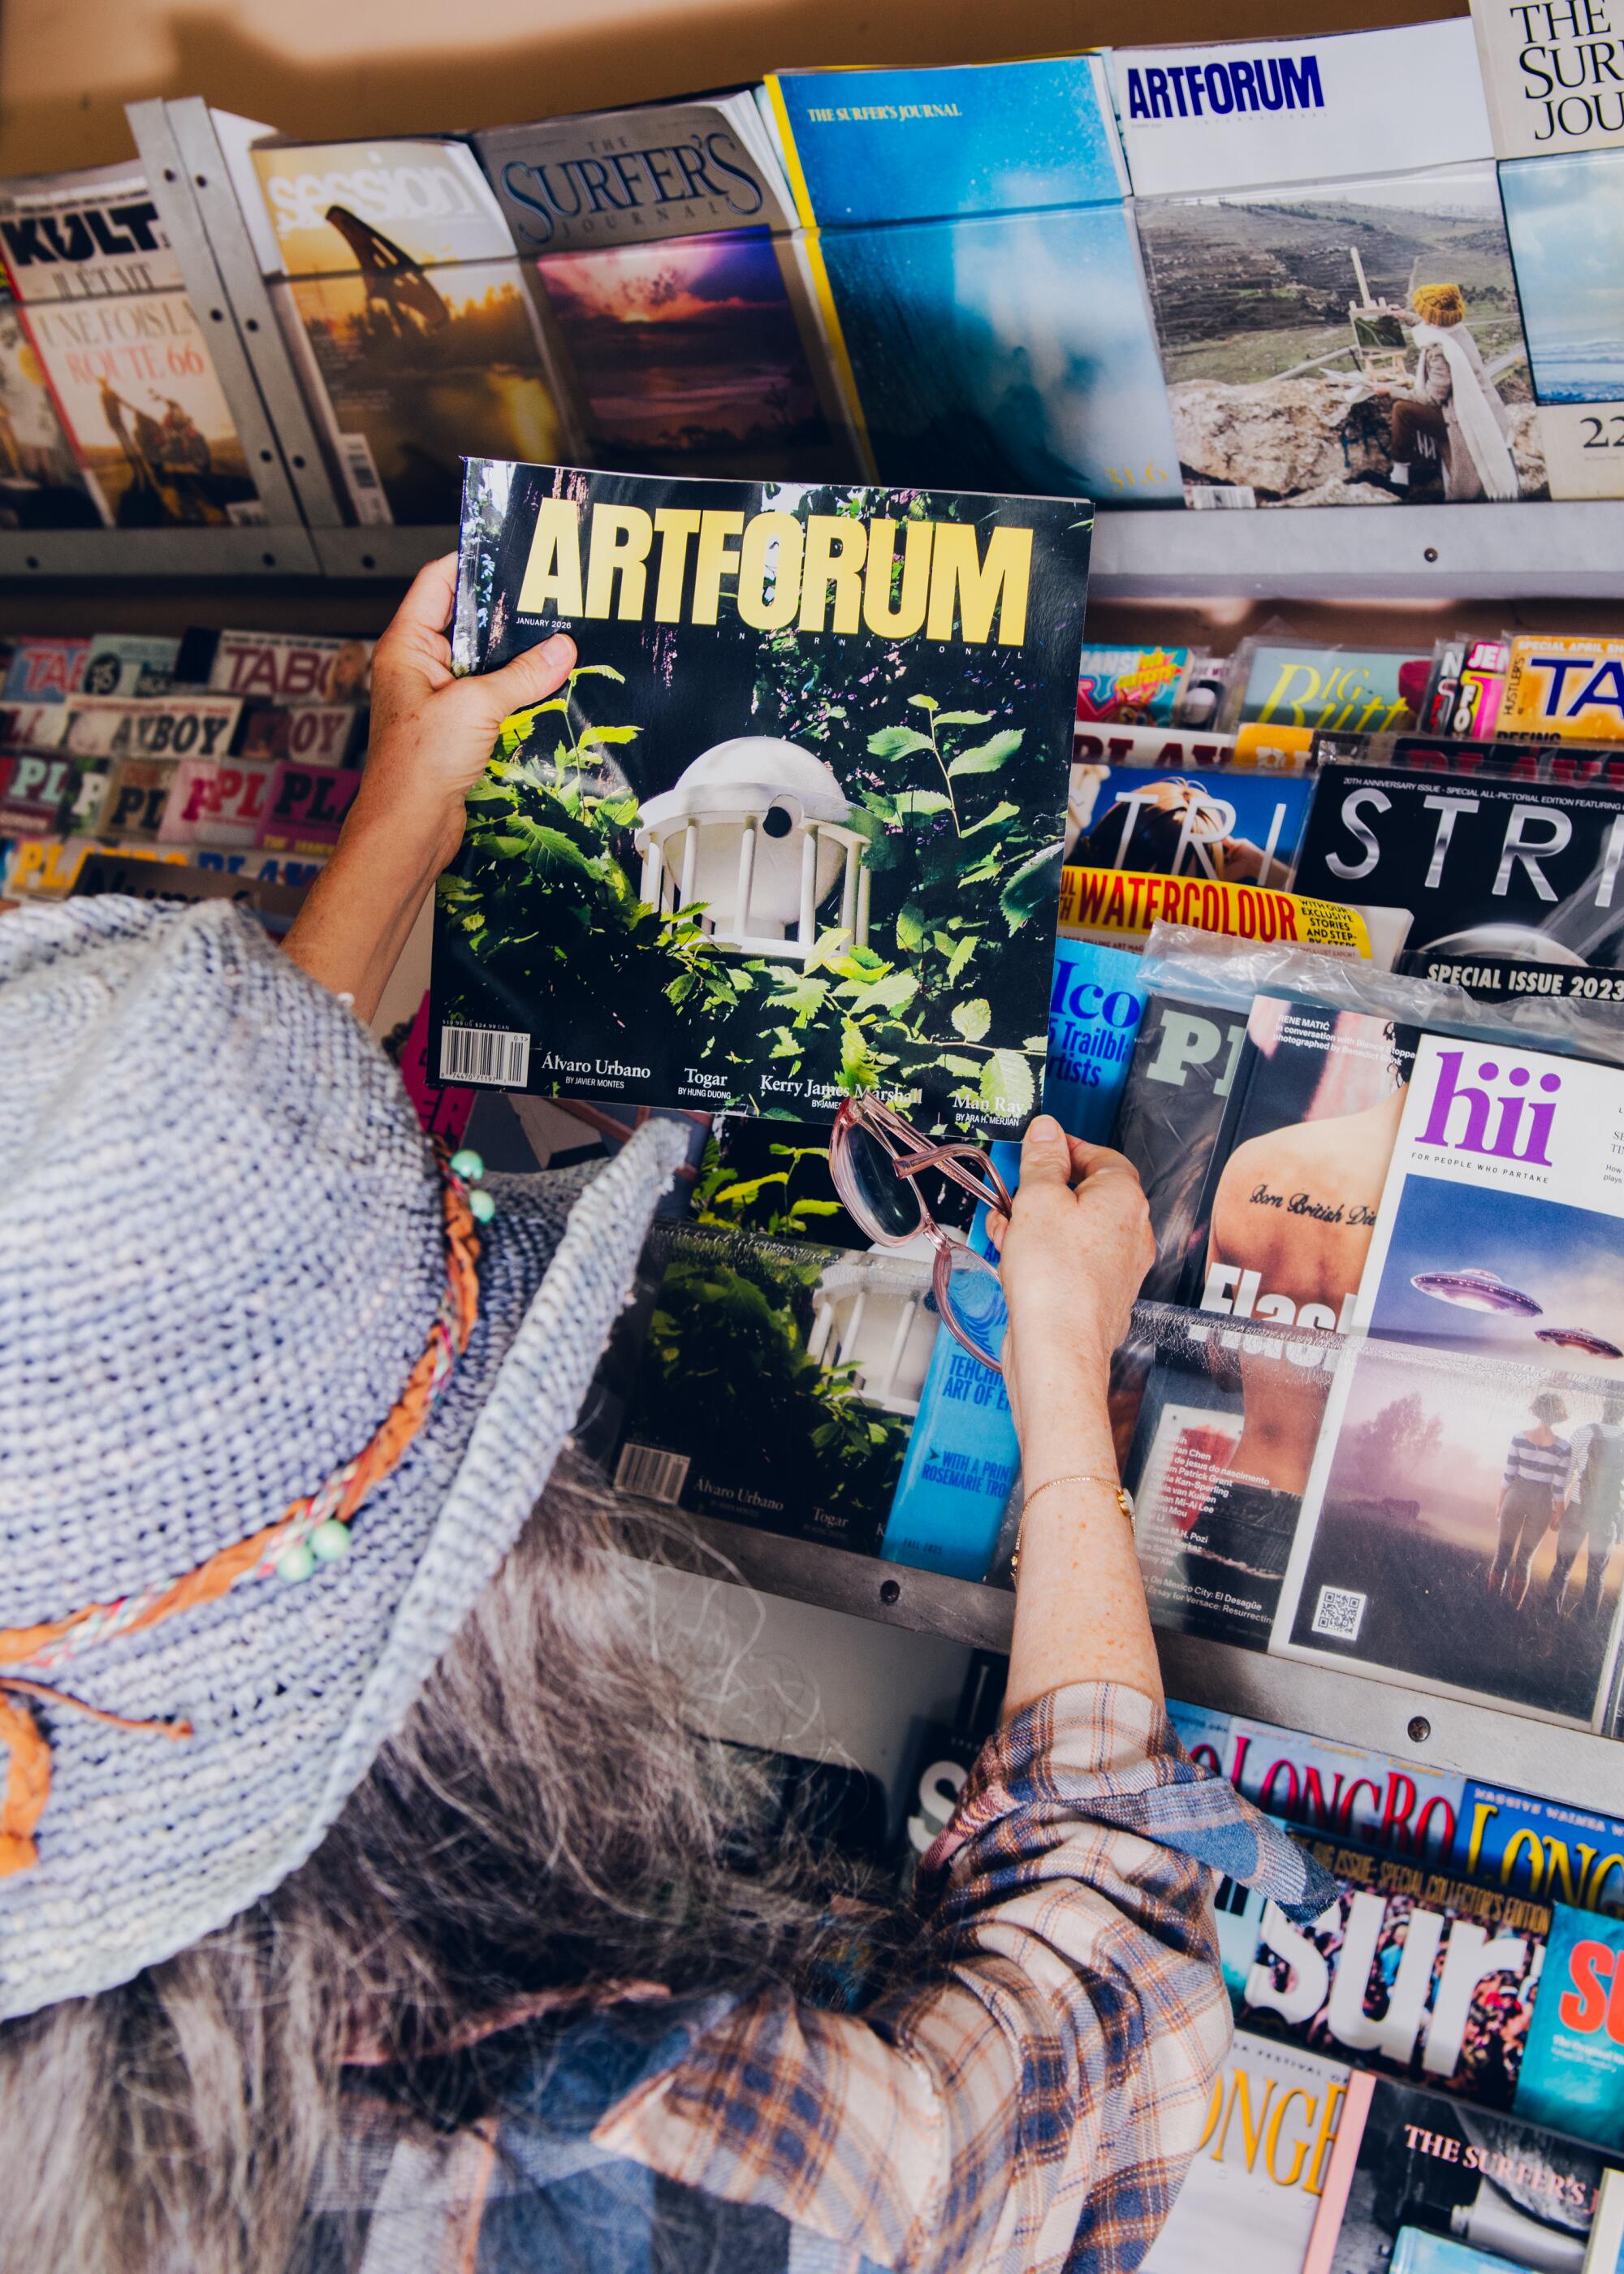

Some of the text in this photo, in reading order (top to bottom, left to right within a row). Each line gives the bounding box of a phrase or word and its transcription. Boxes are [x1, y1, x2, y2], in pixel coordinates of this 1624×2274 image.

[1510, 0, 1612, 44] THE
[1519, 39, 1624, 99] SUR
[1128, 55, 1324, 119] ARTFORUM
[806, 102, 963, 123] THE SURFER'S JOURNAL
[587, 136, 628, 155] THE
[500, 132, 763, 244] SURFER'S
[0, 202, 158, 266] KULT
[167, 341, 205, 378] 66
[516, 495, 1035, 647] ARTFORUM
[516, 617, 572, 630] JANUARY 2026
[716, 630, 1023, 660] INTERNATIONAL
[1343, 777, 1362, 786] 20TH
[1362, 778, 1417, 790] ANNIVERSARY
[1417, 783, 1440, 793] ISSUE
[1445, 786, 1479, 798] SPECIAL
[1480, 789, 1540, 803] ALL-PICTORIAL
[1541, 796, 1575, 806] EDITION
[1575, 799, 1622, 811] FEATURING
[1078, 871, 1298, 943] WATERCOLOUR
[1300, 899, 1348, 913] WITH OUR
[1301, 906, 1354, 923] EXCLUSIVE
[1307, 928, 1358, 941] AND STEP-
[1310, 918, 1350, 931] STORIES
[1426, 962, 1624, 1002] SPECIAL ISSUE 2023
[1272, 1033, 1330, 1051] photographed
[1330, 1044, 1341, 1053] by
[1284, 1027, 1336, 1042] conversation
[1337, 1035, 1355, 1045] with
[542, 1050, 651, 1080] Álvaro Urbano
[565, 1075, 625, 1090] BY JAVIER MONTES
[684, 1067, 729, 1088] Togar
[677, 1086, 732, 1100] BY HUNG DUONG
[760, 1074, 923, 1105] Kerry James Marshall
[811, 1100, 821, 1109] BY
[952, 1093, 1025, 1116] Man Ray
[955, 1113, 1020, 1126] BY ARA H. MERJIAN
[1411, 1152, 1549, 1185] FOR PEOPLE WHO PARTAKE
[1603, 1174, 1622, 1184] plays
[1605, 1164, 1622, 1174] How
[1249, 1183, 1284, 1208] Born
[1287, 1192, 1342, 1225] British
[942, 1376, 993, 1407] ART OF
[942, 1450, 979, 1472] WITH A
[1189, 1448, 1212, 1461] Chen
[921, 1463, 982, 1493] ROSEMARIE
[1174, 1456, 1186, 1466] de
[1185, 1459, 1208, 1472] jesus
[1208, 1463, 1220, 1473] do
[1220, 1468, 1271, 1486] nascimento
[1178, 1466, 1208, 1481] Patrick
[1208, 1474, 1233, 1488] Grant
[695, 1475, 735, 1498] Álvaro
[736, 1488, 785, 1512] Urbano
[1173, 1488, 1187, 1498] van
[812, 1507, 850, 1530] Togar
[1168, 1506, 1188, 1519] Mou
[1198, 1503, 1215, 1515] Lee
[902, 1537, 920, 1550] FALL
[1170, 1528, 1190, 1540] M.H.
[1190, 1533, 1209, 1544] Pozi
[1160, 1556, 1174, 1567] Xie
[1148, 1585, 1171, 1599] Essay
[1172, 1592, 1186, 1602] for
[1186, 1594, 1221, 1610] Versace:
[1163, 1577, 1193, 1593] Mexico
[1194, 1586, 1214, 1599] City:
[1215, 1591, 1224, 1601] El
[1224, 1594, 1263, 1611] Desagüe
[1377, 1859, 1426, 1898] SPECIAL
[1426, 1873, 1505, 1922] COLLECTOR'S
[1503, 1896, 1553, 1936] EDITION
[1403, 2122, 1459, 2164] THE
[1462, 2144, 1586, 2206] SURFER'S
